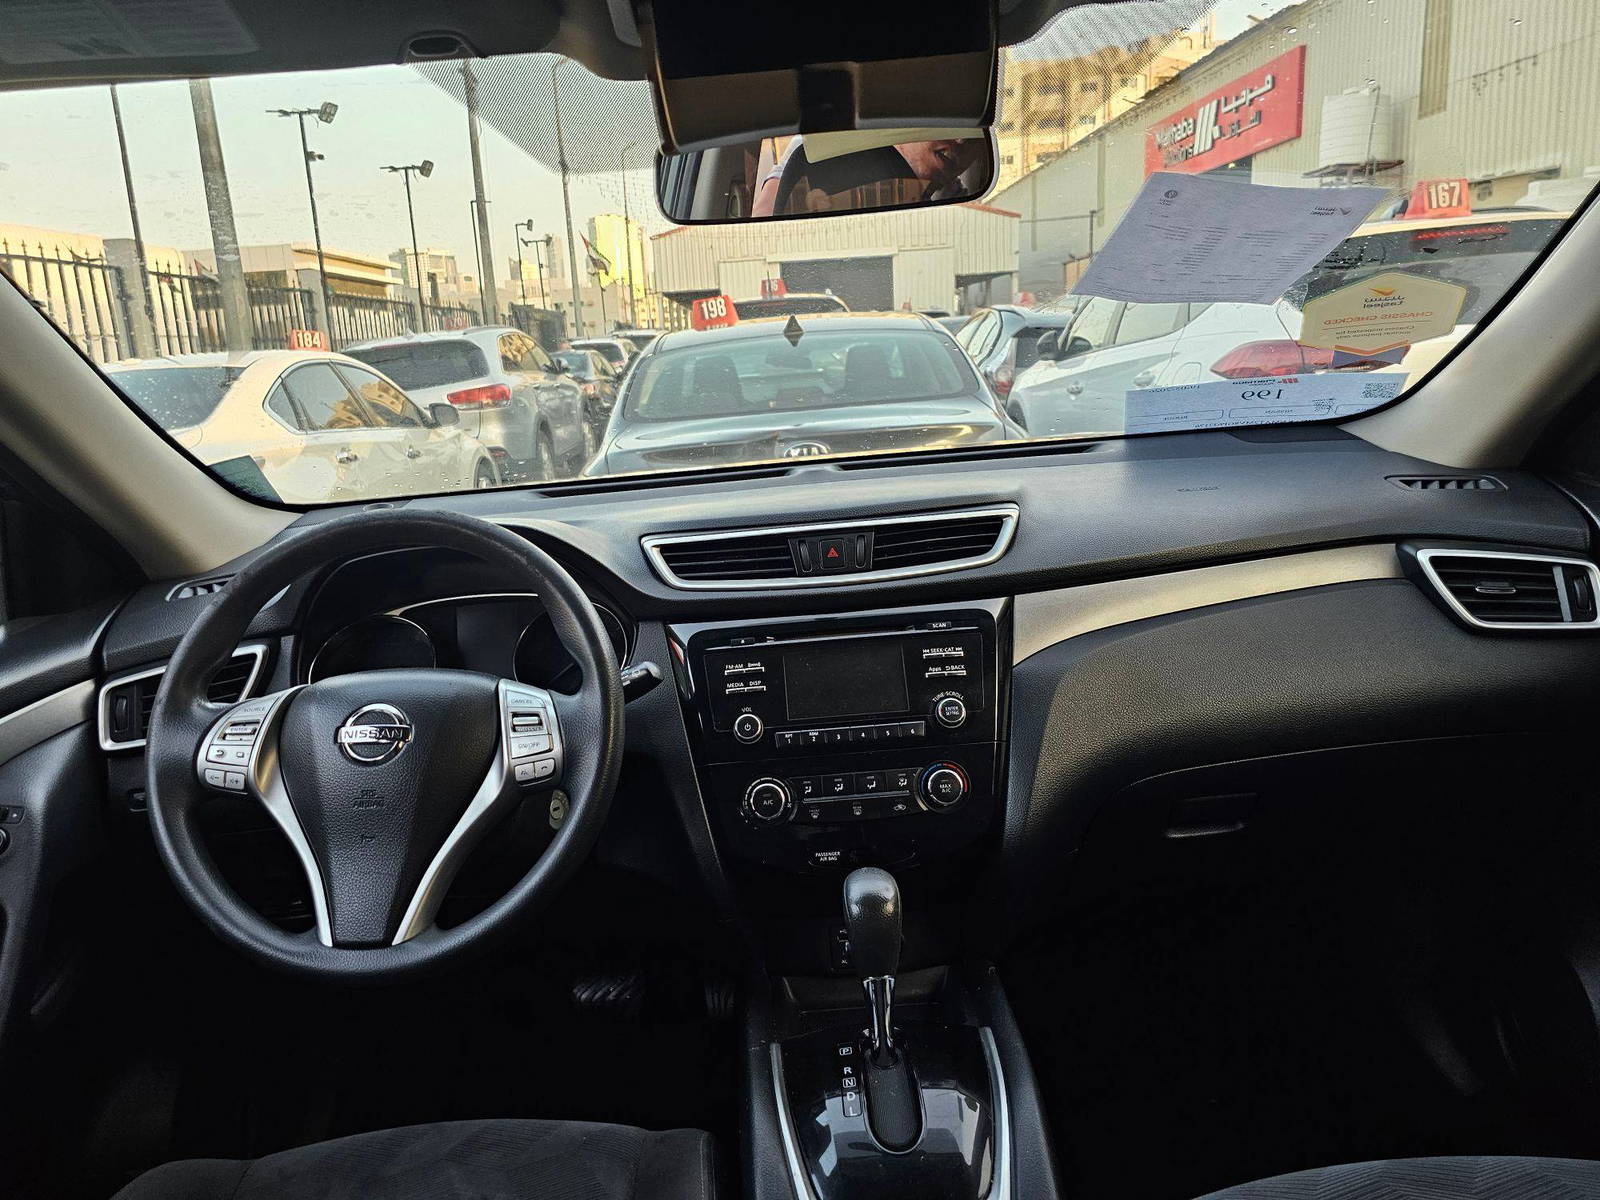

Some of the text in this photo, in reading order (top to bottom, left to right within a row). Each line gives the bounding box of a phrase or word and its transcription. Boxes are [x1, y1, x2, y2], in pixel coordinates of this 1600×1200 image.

[1428, 182, 1460, 209] 167
[701, 296, 728, 321] 198
[297, 333, 321, 348] 184
[790, 446, 819, 457] KIA
[344, 727, 404, 740] NISSAN
[843, 1066, 852, 1074] R
[845, 1078, 854, 1086] N
[846, 1091, 856, 1101] D
[849, 1106, 857, 1117] L
